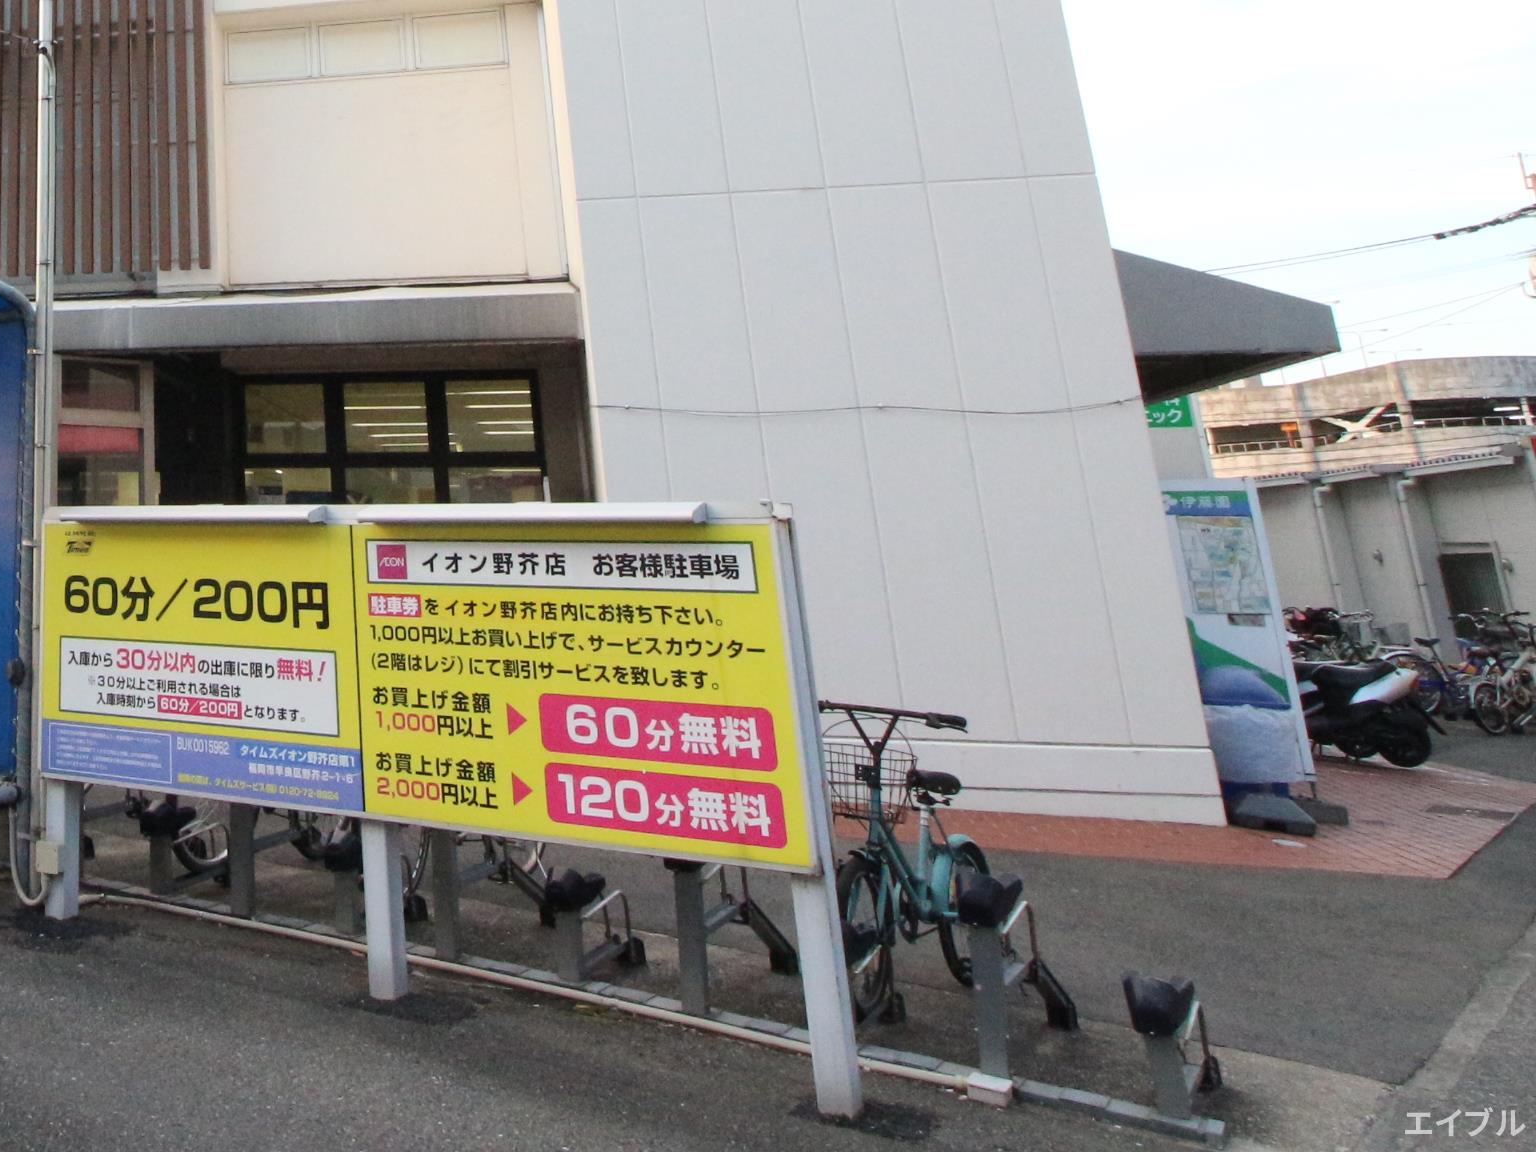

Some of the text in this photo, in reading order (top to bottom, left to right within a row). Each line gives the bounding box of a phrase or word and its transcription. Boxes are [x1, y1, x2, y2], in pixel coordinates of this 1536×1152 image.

[420, 551, 740, 581] イオン野芥店 お客様駐車場
[64, 574, 330, 630] 60分／200円
[369, 624, 766, 658] 1,000円以上お買い上げで、サービスカウンター
[370, 653, 721, 691] (2階はレジ)にて割引サービスを致します。
[372, 687, 492, 714] お買上げ金額
[375, 709, 494, 739] 1,000円以上
[566, 703, 763, 760] 60分無料
[375, 751, 497, 784] お買上げ金額
[375, 777, 499, 810] 2,000円以上
[557, 772, 772, 838] 120分無料
